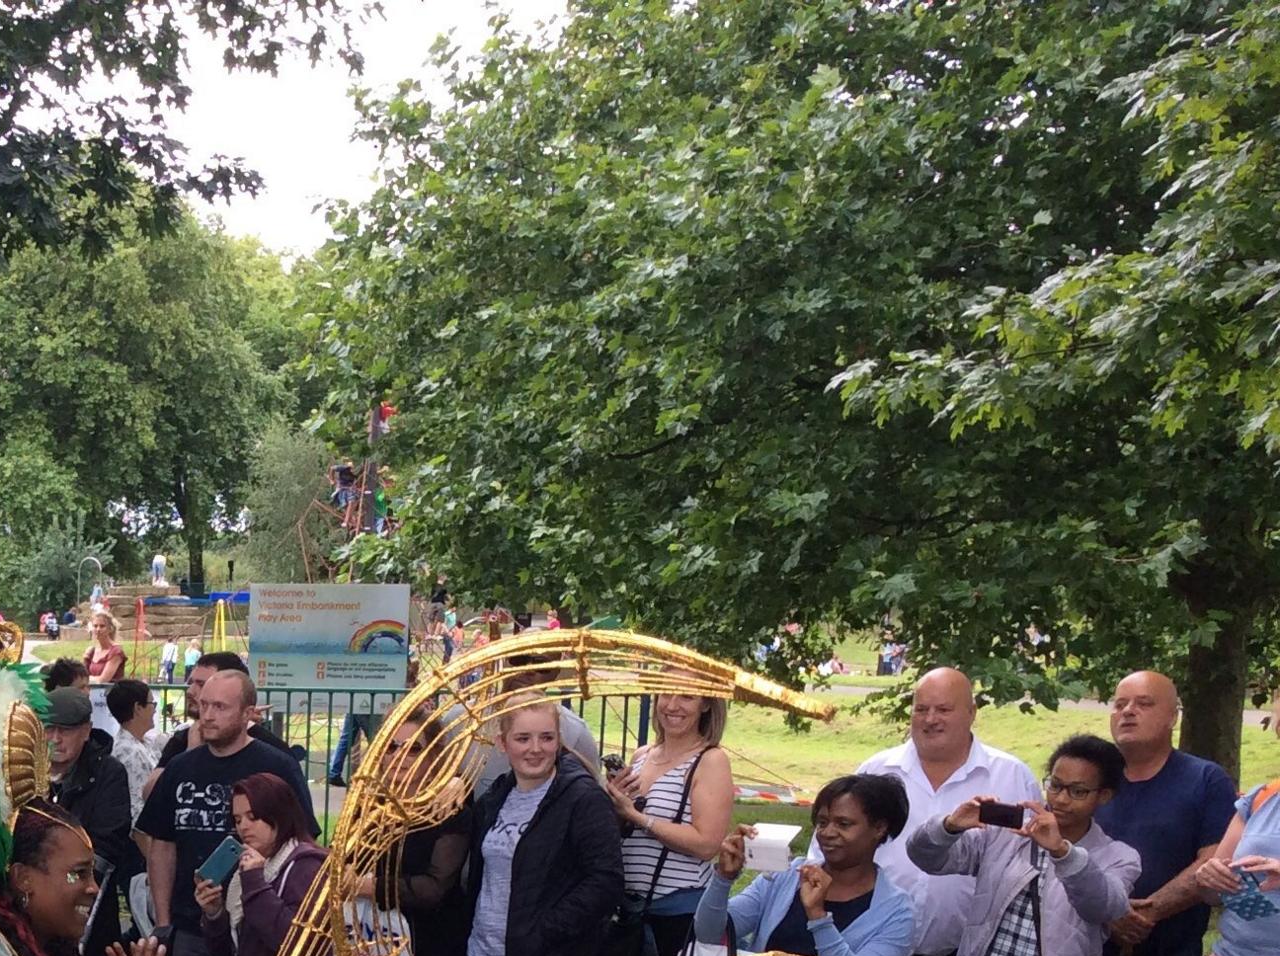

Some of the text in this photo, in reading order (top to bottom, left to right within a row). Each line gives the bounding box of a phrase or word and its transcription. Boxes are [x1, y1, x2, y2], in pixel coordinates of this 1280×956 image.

[260, 588, 316, 598] Welcome to
[259, 601, 361, 610] Victoria Embankment
